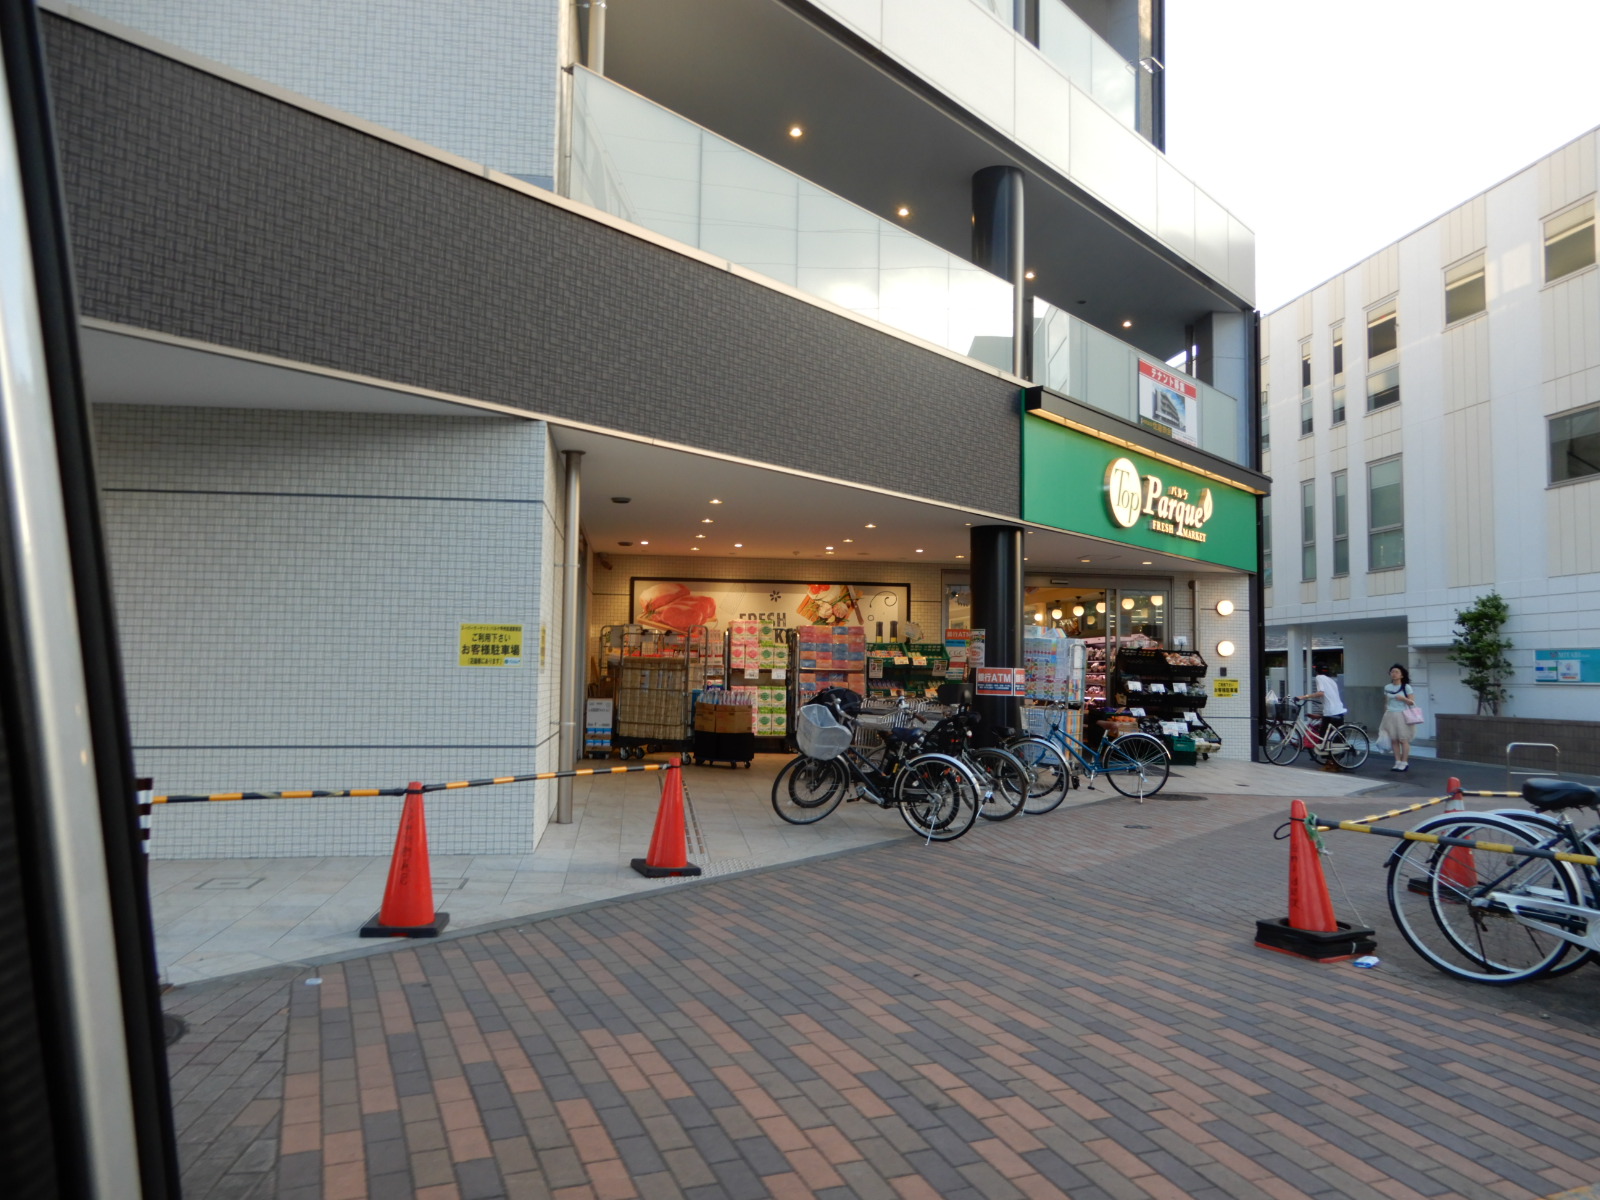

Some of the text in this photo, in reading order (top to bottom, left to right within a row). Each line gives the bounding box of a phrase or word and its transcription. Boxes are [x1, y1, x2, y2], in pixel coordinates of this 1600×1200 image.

[1151, 367, 1186, 393] テナント募集
[1114, 467, 1140, 524] Top
[1143, 474, 1204, 536] Parque
[1152, 519, 1207, 543] FRESH MARKET
[461, 644, 520, 656] お客様駐車場
[472, 633, 511, 643] ご利用下さい
[978, 673, 1011, 683] 銀行ATM
